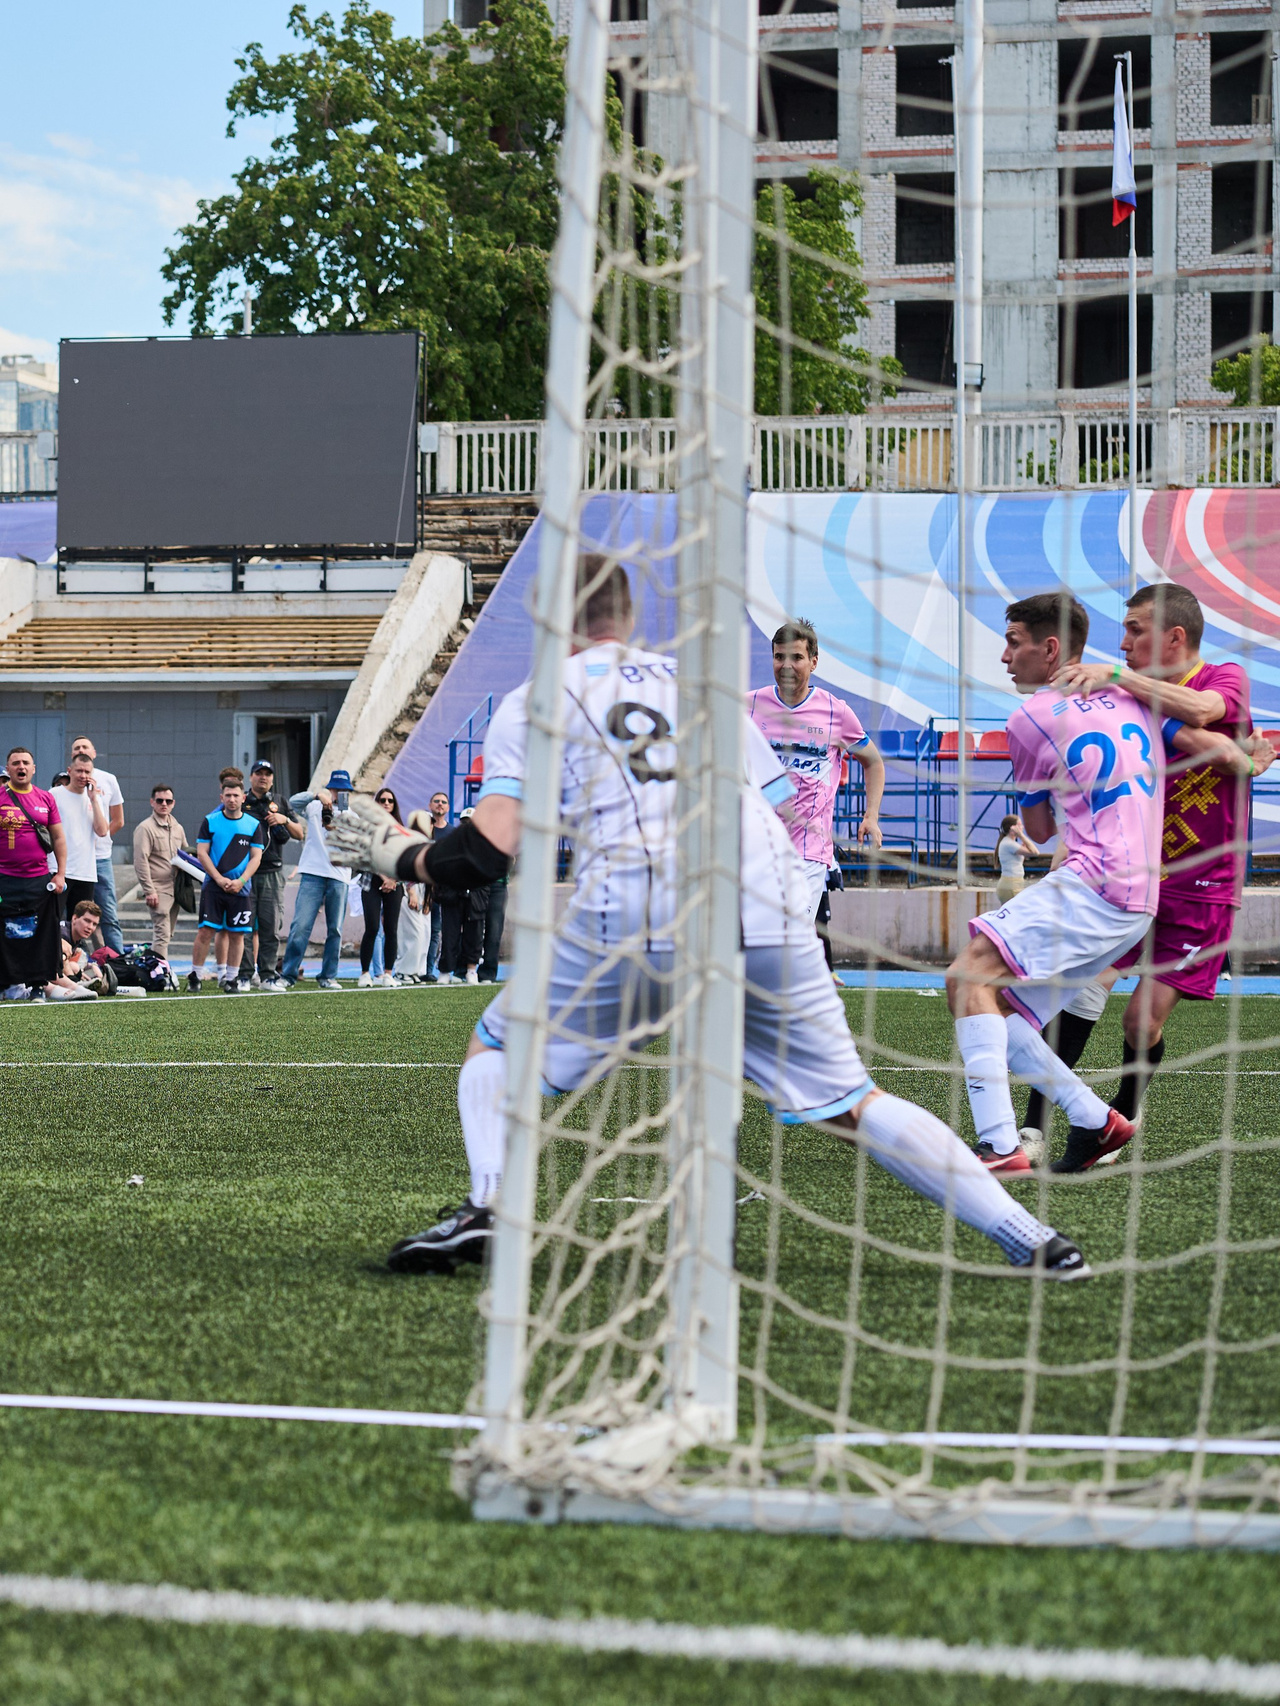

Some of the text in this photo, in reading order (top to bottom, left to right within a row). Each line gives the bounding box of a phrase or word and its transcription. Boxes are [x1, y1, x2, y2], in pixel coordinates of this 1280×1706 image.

[1073, 695, 1116, 713] ВТБ
[807, 726, 824, 735] ВТБ
[1066, 722, 1157, 816] 23
[233, 910, 252, 926] 13
[1174, 943, 1202, 971] 7
